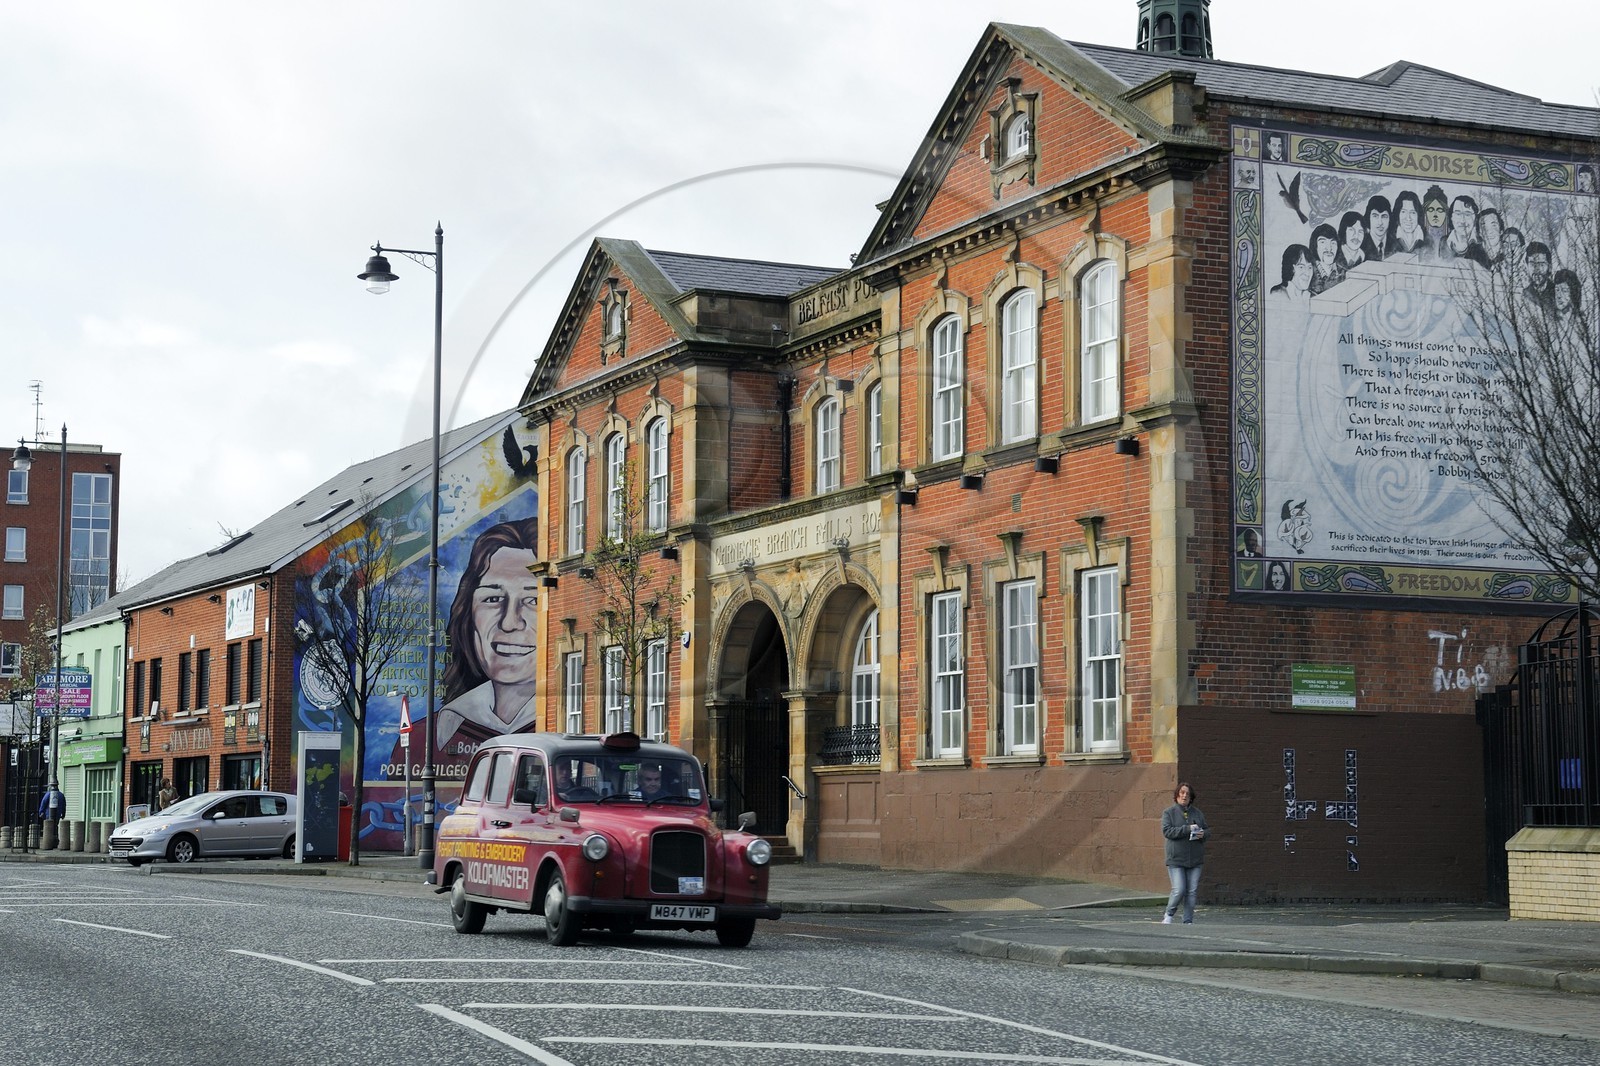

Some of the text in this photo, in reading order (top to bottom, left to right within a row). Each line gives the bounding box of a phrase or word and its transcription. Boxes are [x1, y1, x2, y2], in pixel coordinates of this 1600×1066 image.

[1392, 151, 1475, 175] SAOIRSE
[798, 285, 849, 325] BELFAST
[1338, 334, 1353, 344] All
[1358, 334, 1392, 349] things
[1394, 339, 1423, 350] must
[1426, 342, 1453, 353] come
[1458, 344, 1467, 353] to
[1470, 347, 1493, 356] pass
[1368, 351, 1382, 362] So
[1386, 352, 1410, 365] hope
[1415, 355, 1448, 366] should
[1452, 361, 1480, 370] never
[1342, 364, 1373, 377] There
[1378, 367, 1385, 377] is
[1389, 371, 1401, 379] no
[1405, 370, 1439, 383] height
[1457, 373, 1490, 387] bloody
[1365, 382, 1391, 394] That
[1404, 385, 1449, 398] freeman
[1452, 390, 1477, 400] can't
[1346, 397, 1377, 409] There
[1381, 399, 1389, 409] is
[1393, 403, 1405, 411] no
[1409, 404, 1442, 414] source
[1445, 406, 1456, 414] or
[1458, 404, 1495, 419] foreign
[1349, 413, 1371, 425] Can
[1374, 414, 1404, 427] break
[1408, 420, 1425, 428] one
[1429, 421, 1454, 430] man
[1457, 421, 1480, 432] who
[1346, 430, 1372, 441] That
[1375, 431, 1391, 442] his
[1394, 433, 1414, 443] free
[1417, 434, 1436, 444] will
[1440, 438, 1452, 446] no
[1456, 437, 1483, 450] thing
[1355, 446, 1378, 457] And
[1381, 446, 1407, 457] from
[1410, 448, 1431, 460] that
[1438, 465, 1471, 479] Bobby
[767, 525, 807, 555] BRANCH
[815, 516, 852, 545] FALLS
[1328, 532, 1345, 540] This
[1356, 534, 1391, 543] dedicated
[1402, 536, 1414, 544] the
[1429, 537, 1450, 545] brave
[1452, 539, 1469, 547] Irish
[1470, 540, 1497, 550] hunger
[1331, 544, 1367, 552] sacrificed
[1370, 545, 1387, 553] their
[1389, 546, 1405, 554] lives
[1437, 549, 1454, 557] Their
[1398, 573, 1481, 592] FREEDOM
[377, 616, 445, 629] REPUBLICN
[393, 651, 425, 663] THEIR
[41, 675, 88, 683] ARMORE
[402, 685, 418, 696] TO
[422, 684, 449, 698] PAY
[480, 844, 485, 858] &
[655, 906, 685, 918] M847
